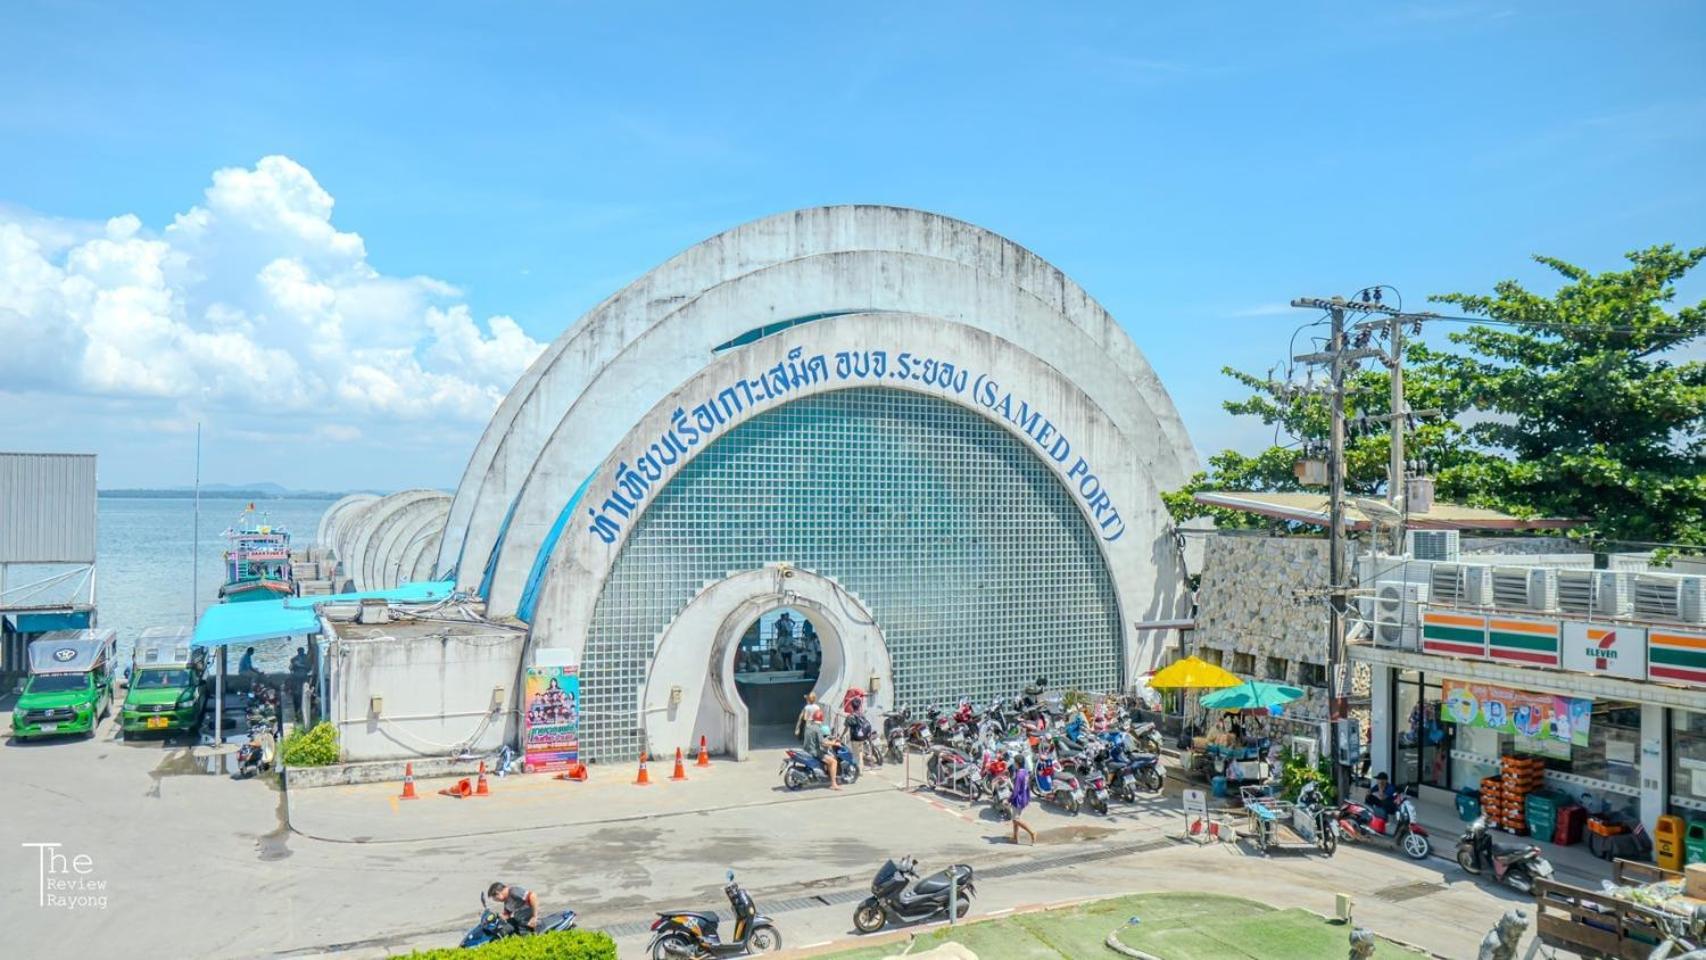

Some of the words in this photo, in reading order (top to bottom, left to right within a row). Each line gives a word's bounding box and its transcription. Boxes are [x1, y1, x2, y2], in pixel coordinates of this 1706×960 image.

[835, 351, 967, 393] อบจ.ระยอง
[973, 373, 1071, 463] (SAMED
[1067, 456, 1126, 542] PORT)
[1587, 629, 1617, 670] 7
